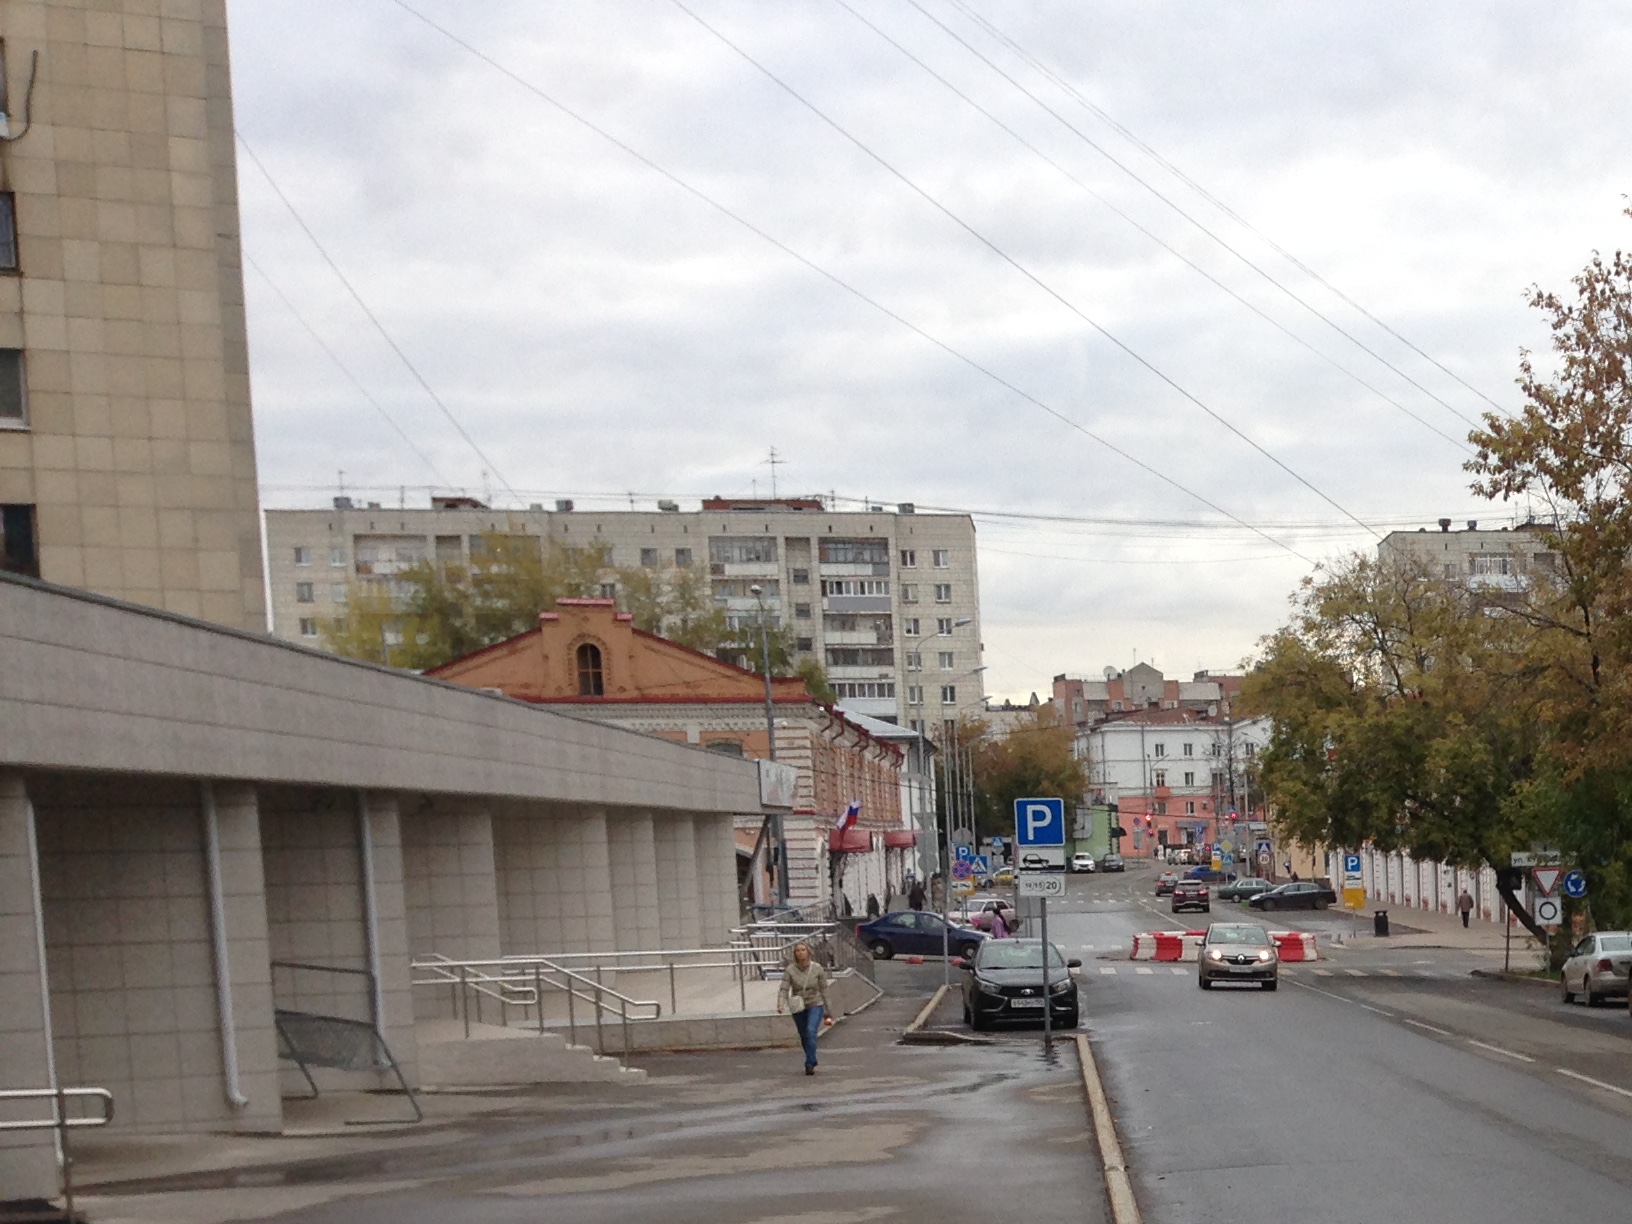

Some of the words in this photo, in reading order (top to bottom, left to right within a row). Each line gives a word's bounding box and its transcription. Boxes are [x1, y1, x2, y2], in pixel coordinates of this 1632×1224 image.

[1026, 804, 1052, 840] P
[1347, 856, 1358, 871] P
[1045, 881, 1058, 890] 20
